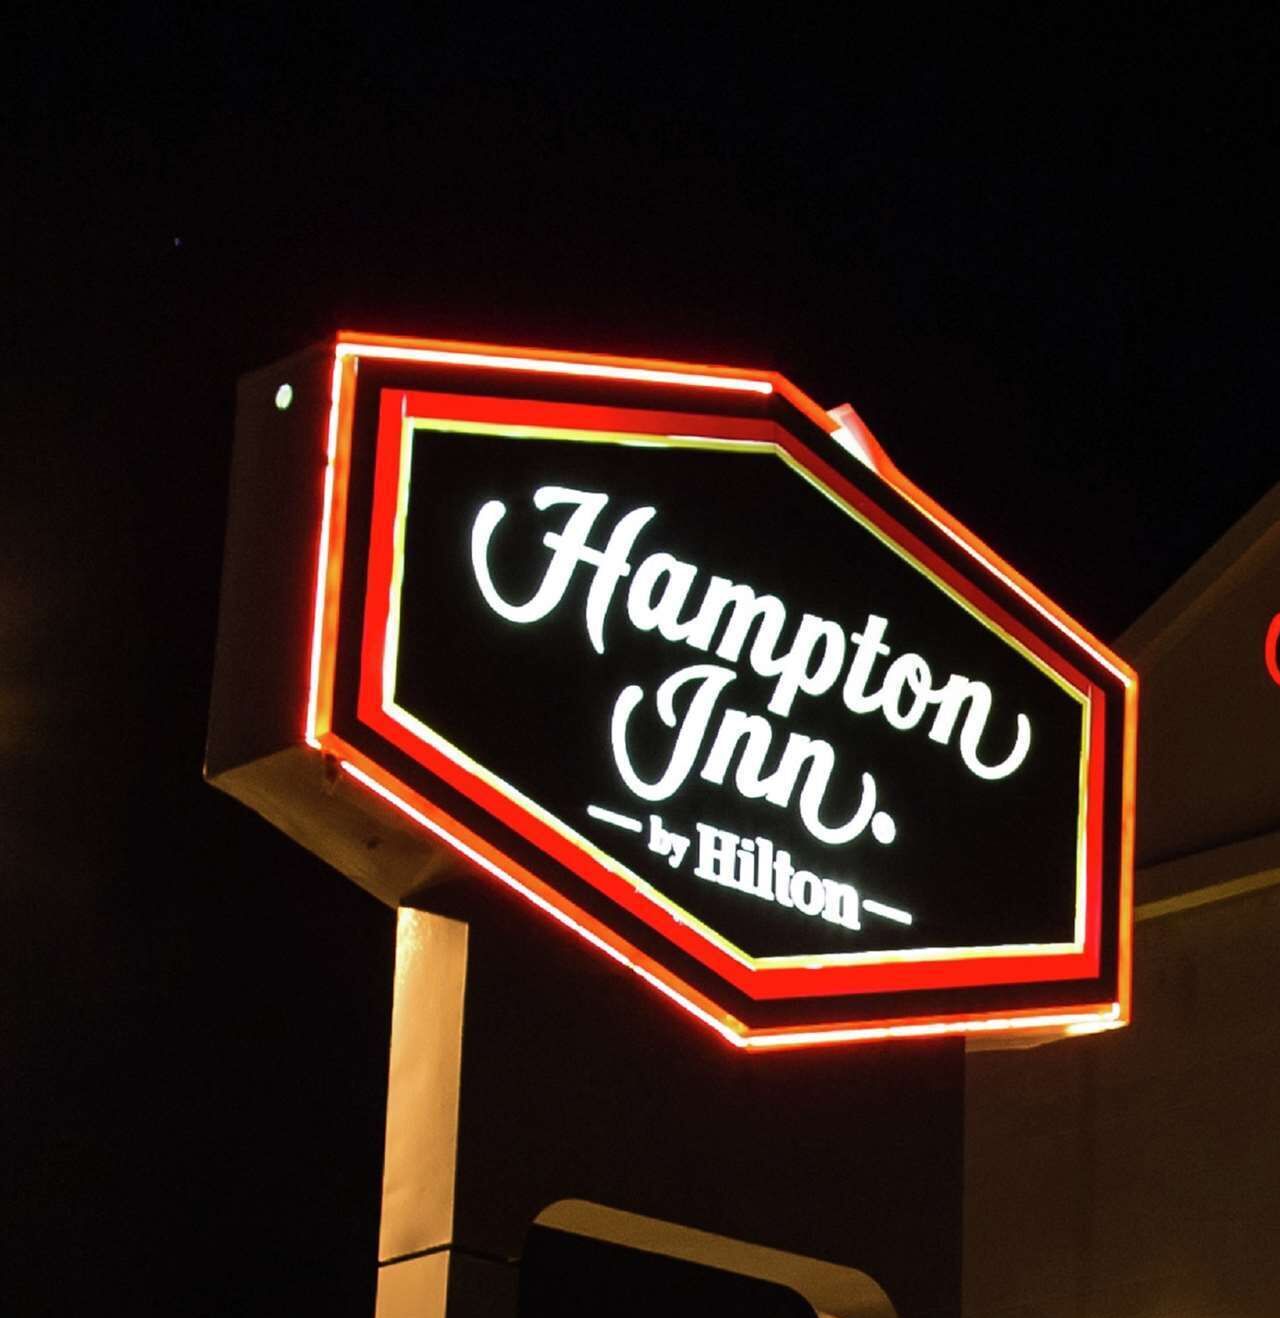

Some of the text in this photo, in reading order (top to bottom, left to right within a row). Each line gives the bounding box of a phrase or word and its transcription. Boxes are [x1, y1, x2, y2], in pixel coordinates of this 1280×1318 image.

[471, 485, 1031, 780] Hampton
[648, 814, 861, 931] by Hilton
